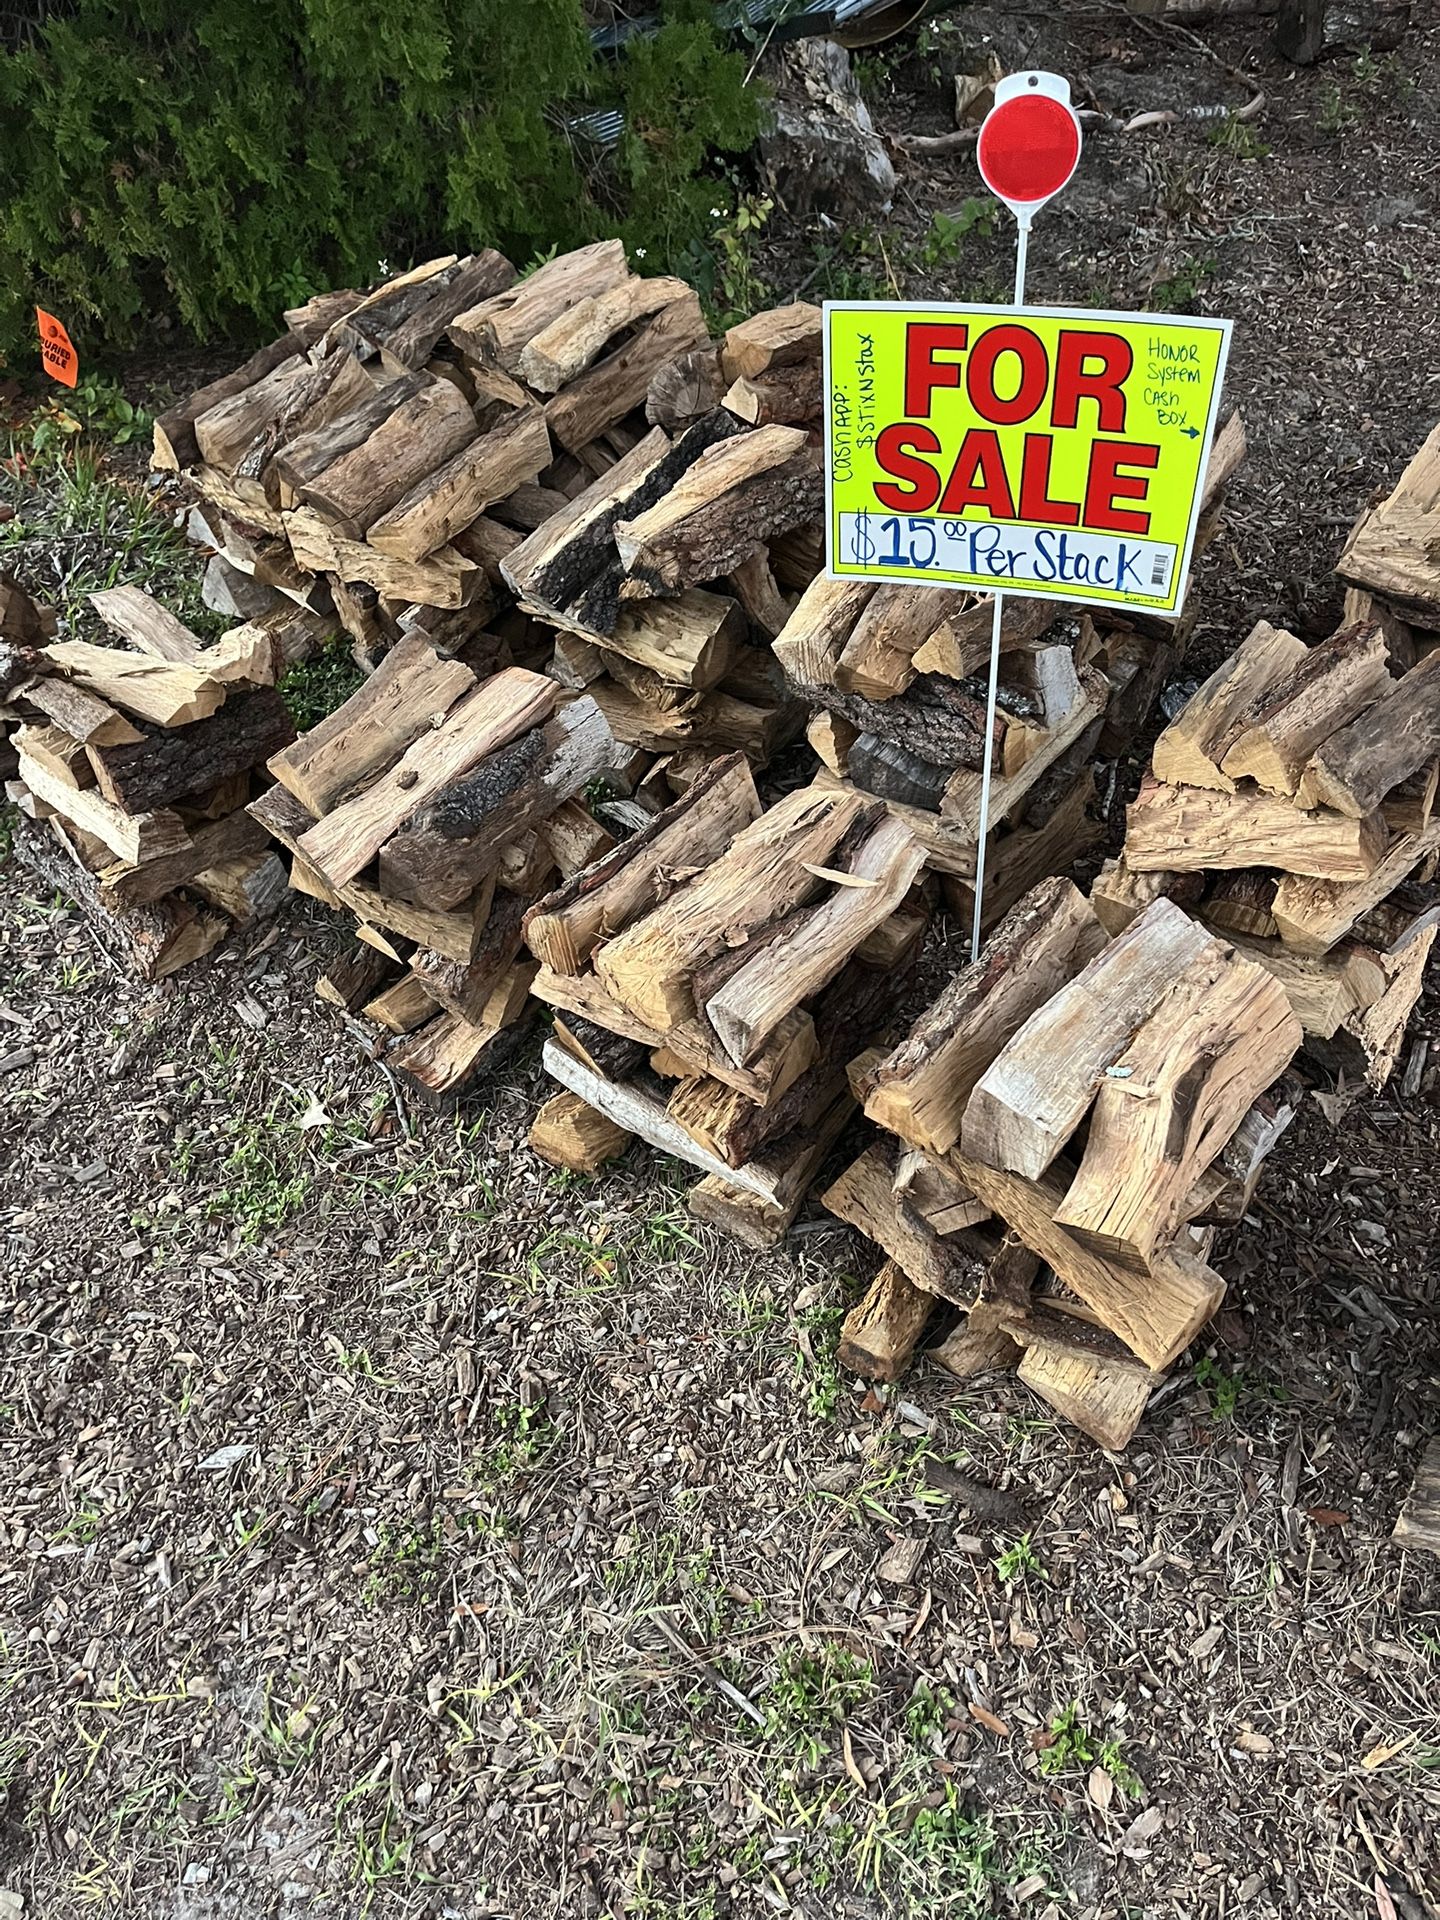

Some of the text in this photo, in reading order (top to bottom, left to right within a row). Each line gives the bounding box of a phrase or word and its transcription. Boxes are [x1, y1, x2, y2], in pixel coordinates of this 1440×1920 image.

[43, 348, 68, 369] ABLE
[904, 322, 1134, 434] FOR
[1148, 337, 1200, 363] HONOR
[873, 422, 1160, 535] SALE
[969, 525, 1028, 577] Per
[1032, 530, 1144, 591] Stack
